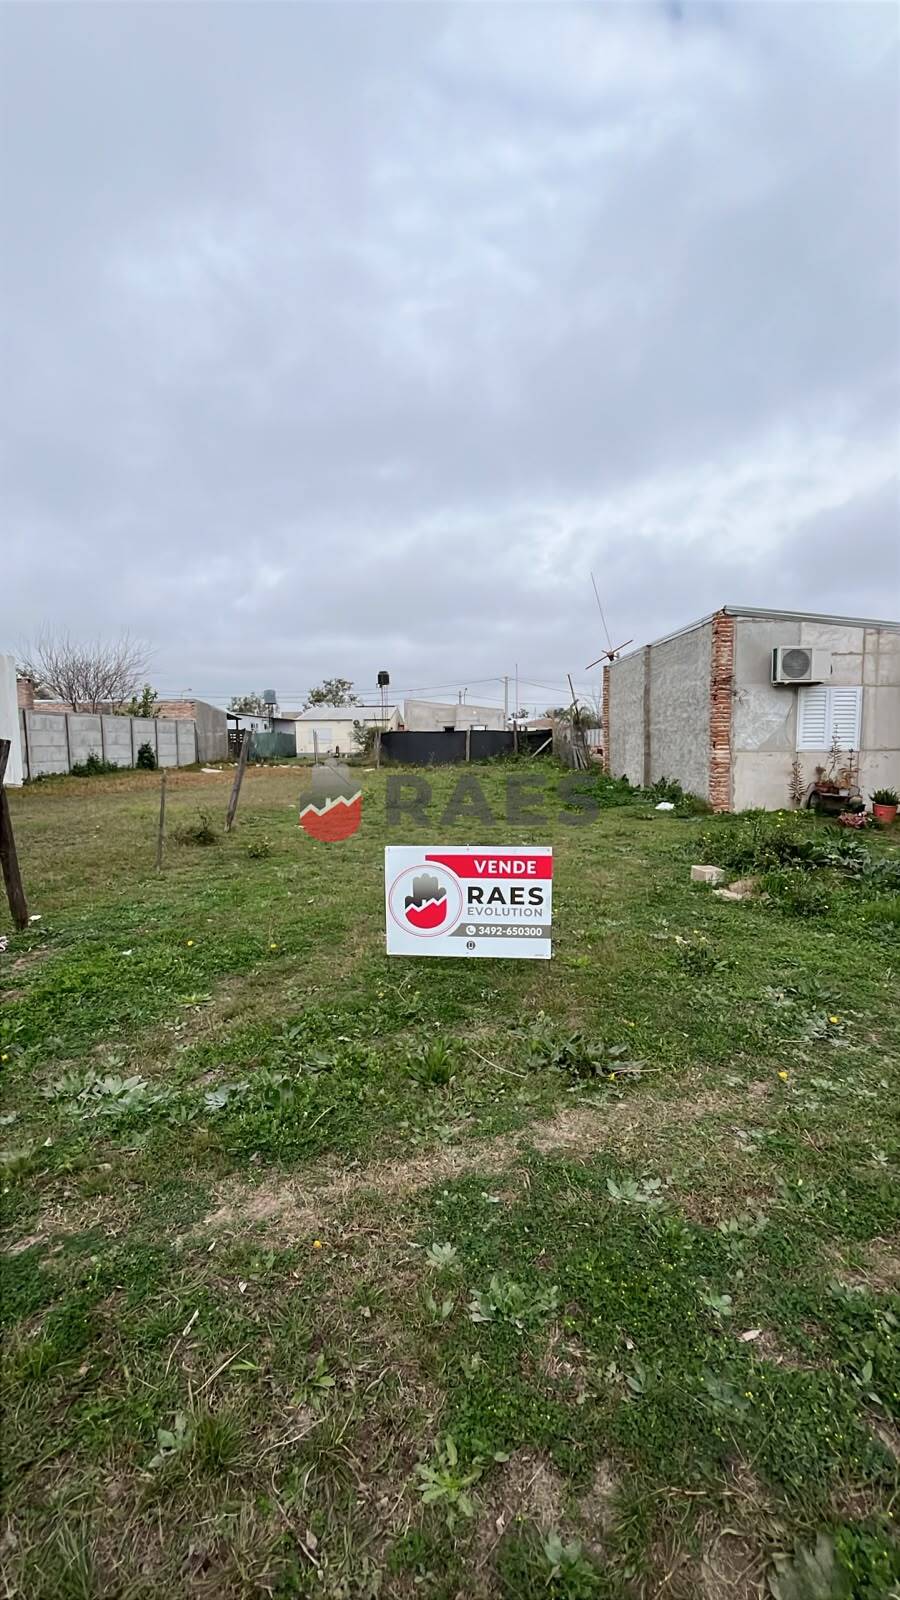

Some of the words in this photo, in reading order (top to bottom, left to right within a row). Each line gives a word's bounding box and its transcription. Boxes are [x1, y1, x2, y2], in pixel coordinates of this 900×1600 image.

[474, 860, 537, 874] VENDE
[467, 886, 544, 905] RAES
[467, 907, 543, 917] EVOLUTION
[478, 926, 543, 936] 3492-650300
